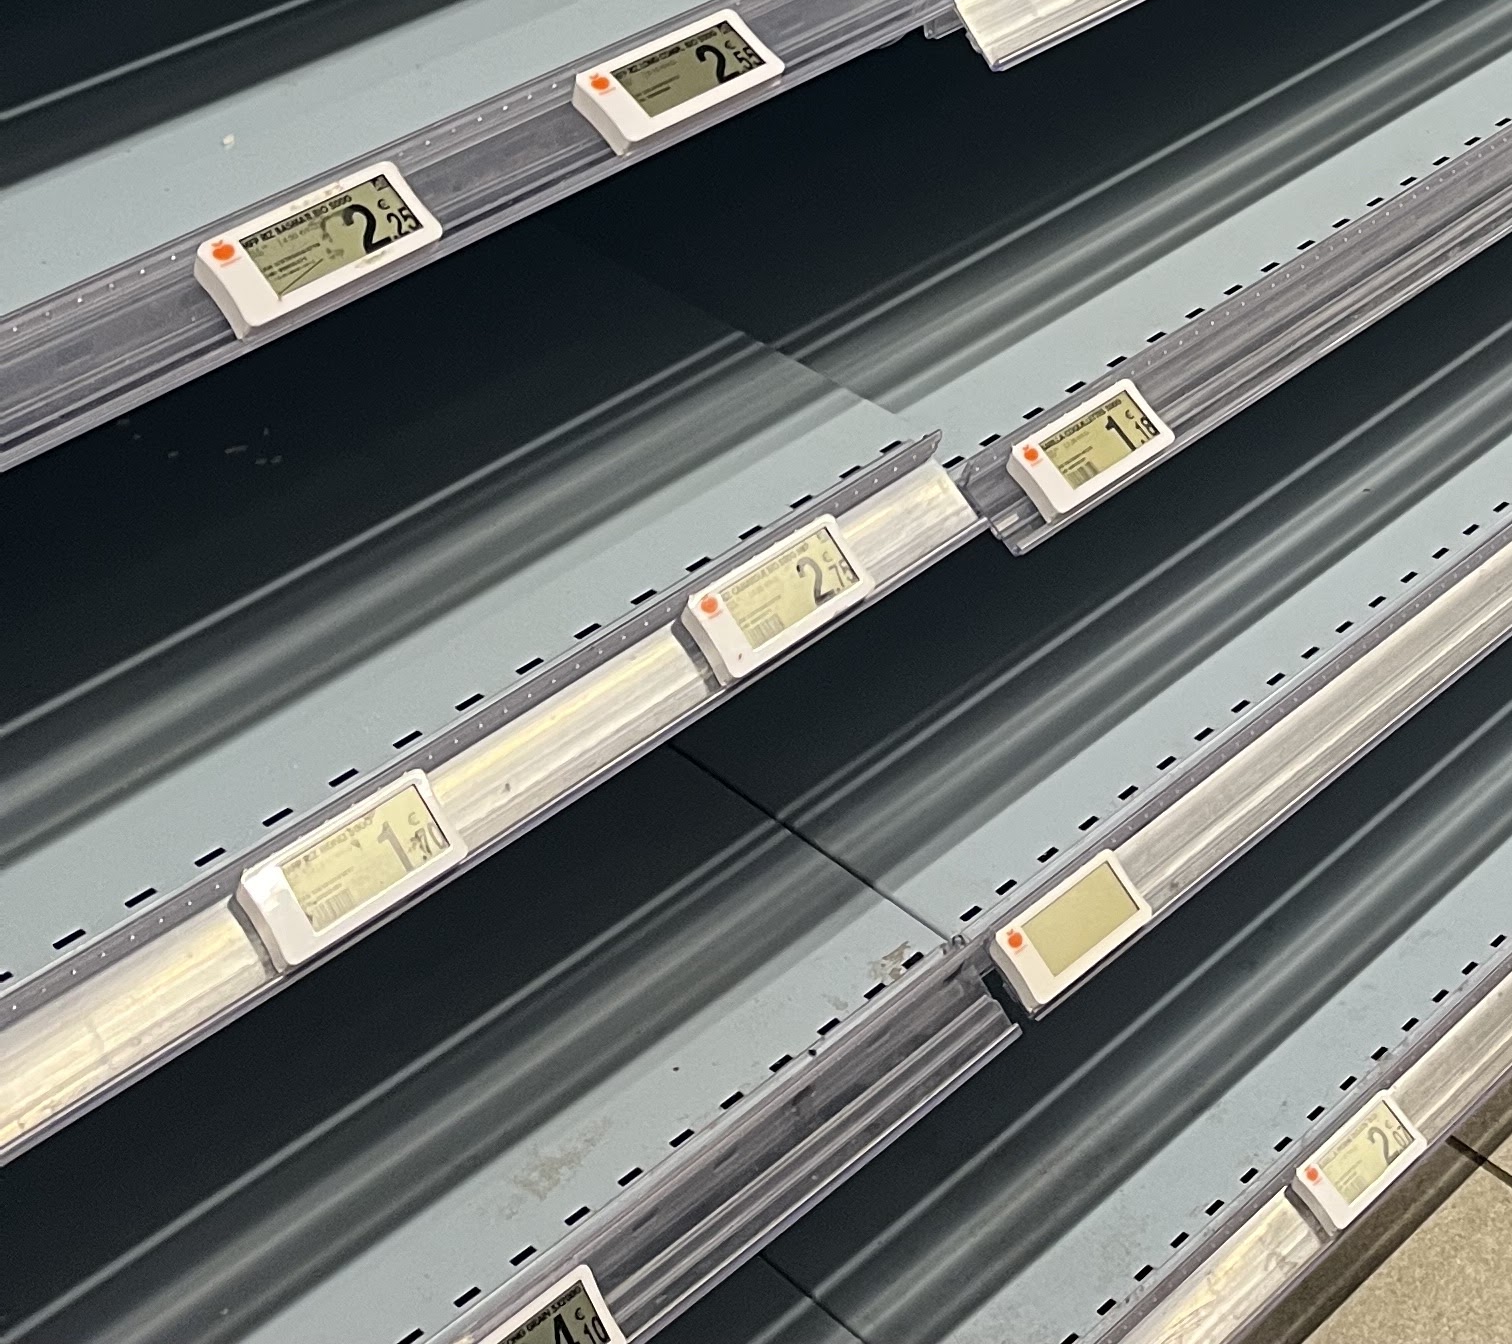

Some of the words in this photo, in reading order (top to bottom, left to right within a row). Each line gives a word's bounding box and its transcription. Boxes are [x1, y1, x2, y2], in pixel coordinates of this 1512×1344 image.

[693, 44, 764, 85] 2.55
[341, 204, 421, 255] 2.25
[1104, 414, 1159, 451] 1.18
[795, 556, 856, 608] 2.75
[377, 820, 446, 872] 1.70
